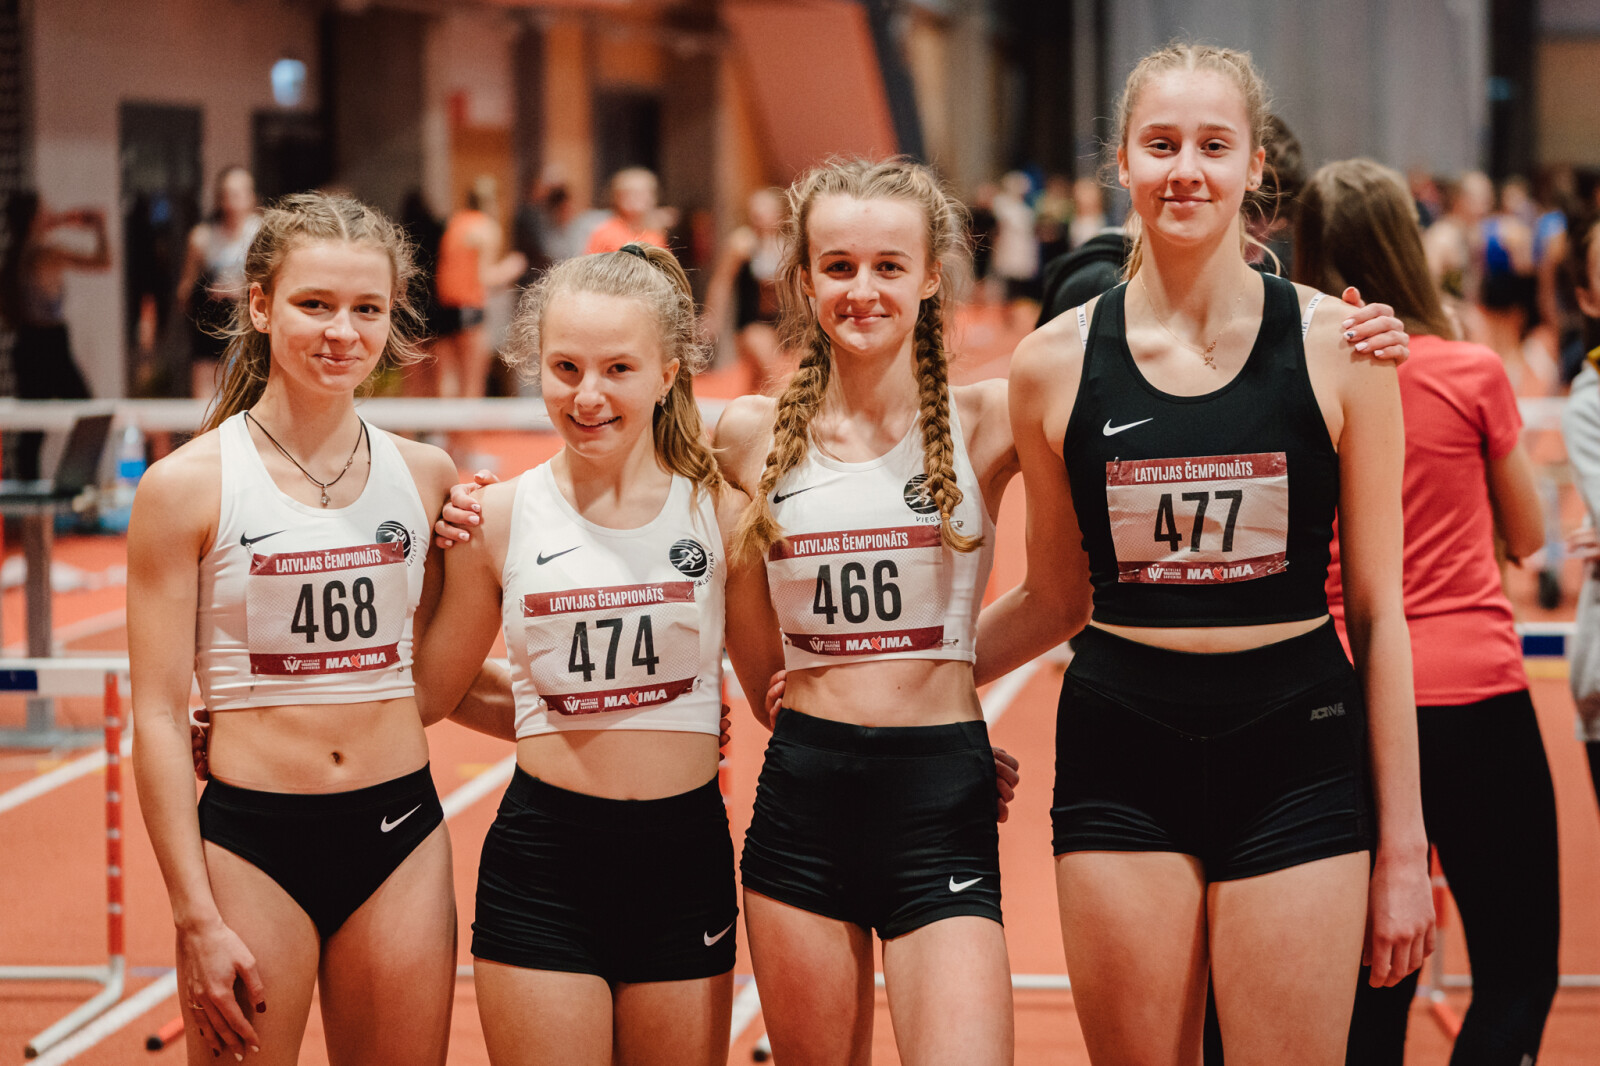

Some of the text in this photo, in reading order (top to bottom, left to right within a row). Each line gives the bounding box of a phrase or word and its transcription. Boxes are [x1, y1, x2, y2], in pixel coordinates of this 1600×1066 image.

[1134, 459, 1254, 483] LATVIJAS ČEMPIONĀTS
[1154, 489, 1243, 553] 477
[793, 530, 909, 555] LATVIJAS ČEMPIONĀTS
[275, 547, 382, 574] LATVIJAS ČEMPIONĀTS
[1186, 564, 1255, 581] MAXIMA
[549, 586, 665, 613] LATVIJAS ČEMPIONĀTS
[813, 559, 902, 625] 466
[290, 576, 378, 644] 468
[568, 614, 660, 683] 474
[845, 634, 913, 651] MAXIMA
[325, 651, 387, 669] MAXIMA
[603, 688, 668, 708] MAXIMA
